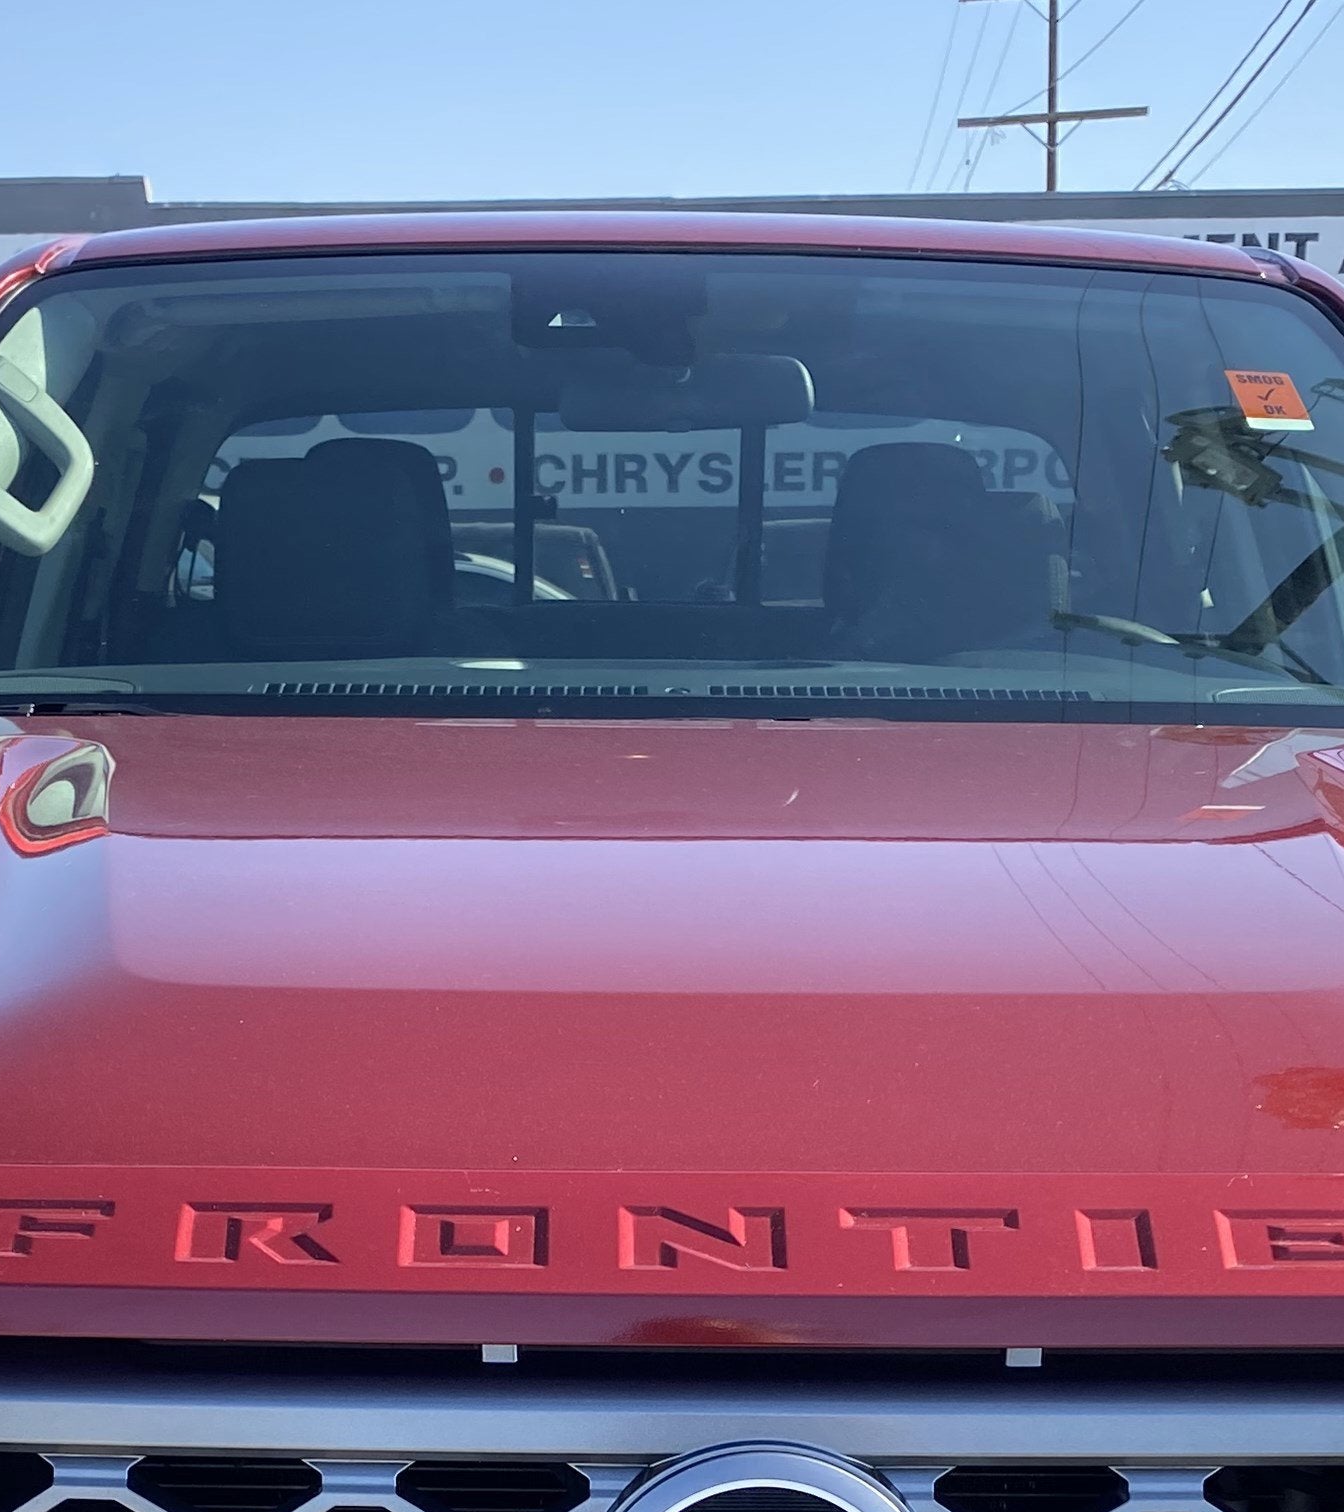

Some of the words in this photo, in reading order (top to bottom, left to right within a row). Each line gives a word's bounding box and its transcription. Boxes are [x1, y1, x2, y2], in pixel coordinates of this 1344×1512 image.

[1235, 373, 1285, 386] SMOG
[1263, 404, 1287, 415] OK
[534, 449, 850, 494] CHRYSER
